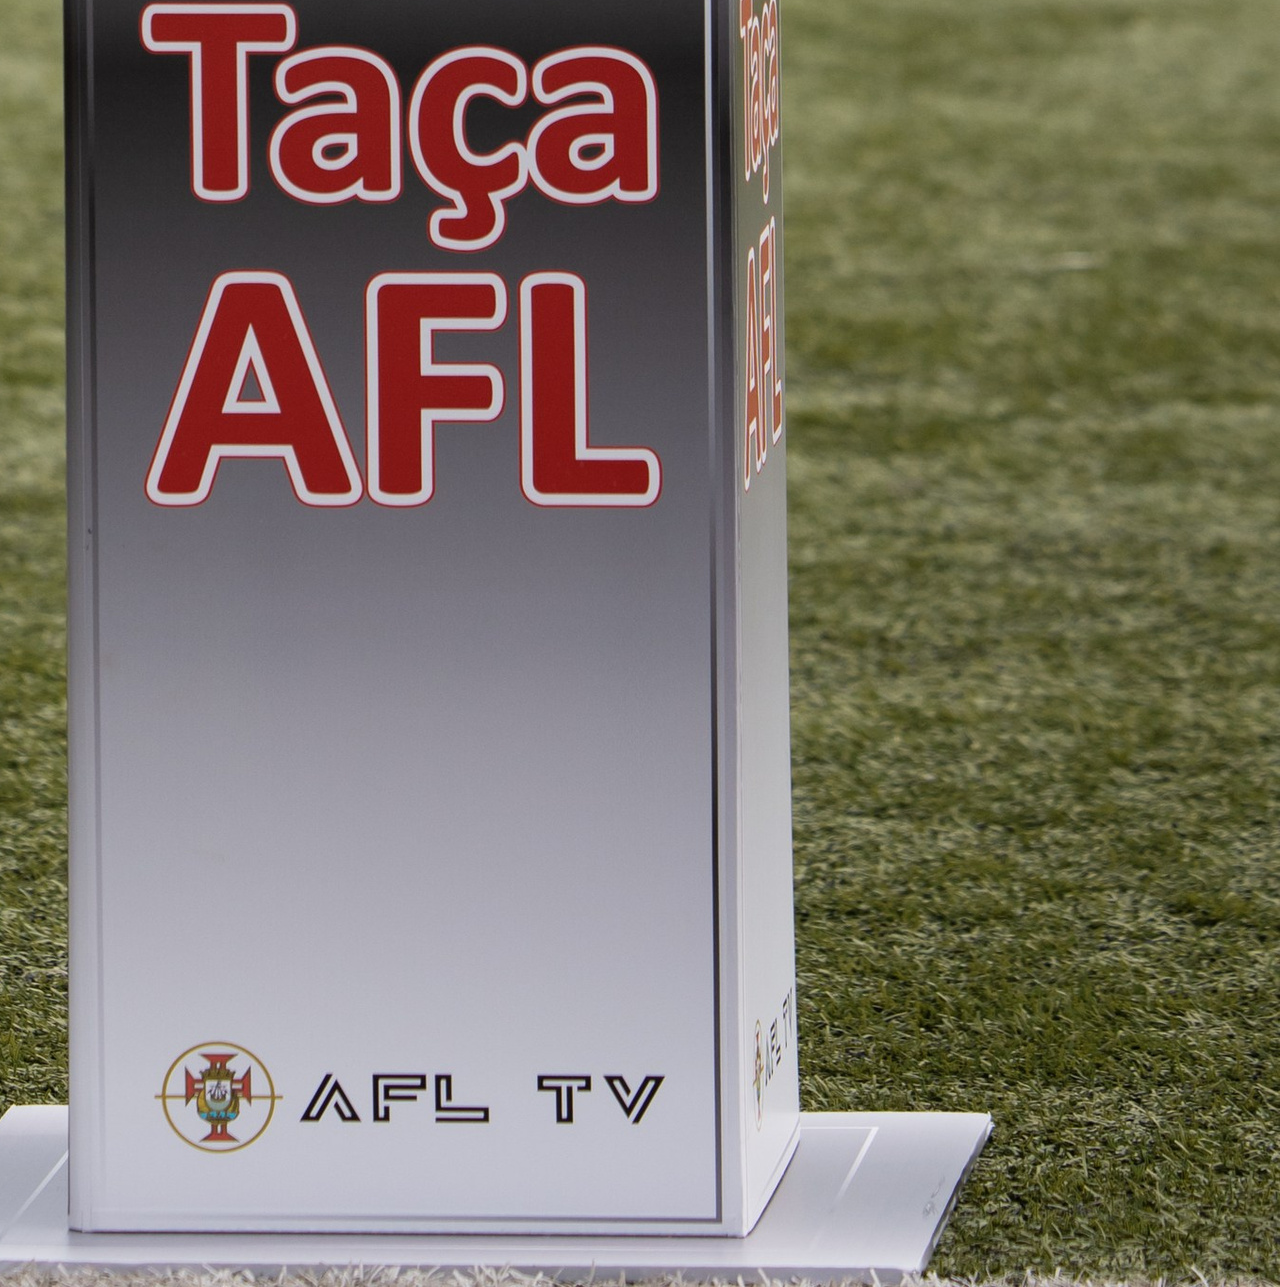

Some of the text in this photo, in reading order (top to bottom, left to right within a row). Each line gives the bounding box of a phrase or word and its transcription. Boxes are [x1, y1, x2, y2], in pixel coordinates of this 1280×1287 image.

[142, 2, 659, 251] Taça
[145, 270, 662, 506] AFL
[744, 215, 782, 492] AFL
[299, 1073, 666, 1124] AFL TV
